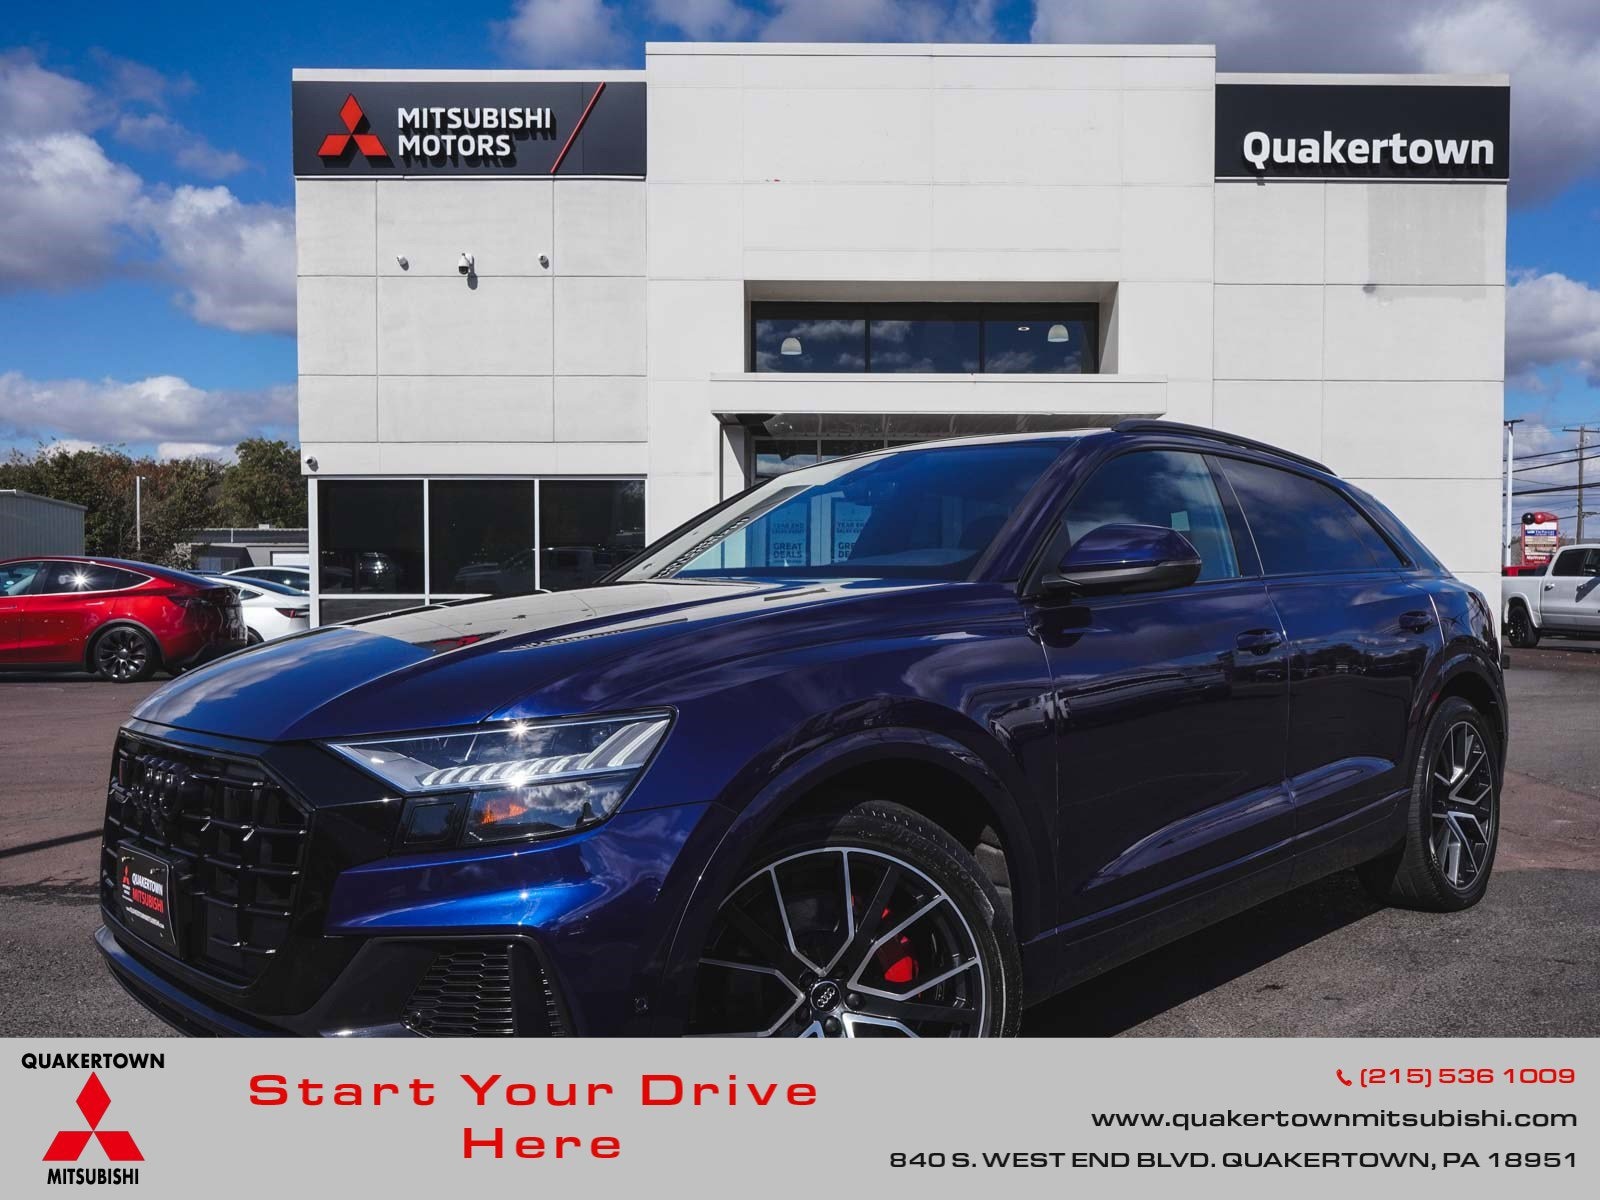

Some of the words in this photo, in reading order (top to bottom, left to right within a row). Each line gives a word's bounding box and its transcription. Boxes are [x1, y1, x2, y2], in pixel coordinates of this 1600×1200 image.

[398, 107, 551, 129] MITSUBISHI
[398, 134, 511, 157] MOTORS
[1243, 130, 1495, 170] Quakertown
[773, 542, 802, 550] GREAT
[773, 550, 802, 559] DEALS
[131, 872, 163, 897] QUAKERTOWN
[132, 887, 164, 914] MITSUBISHI
